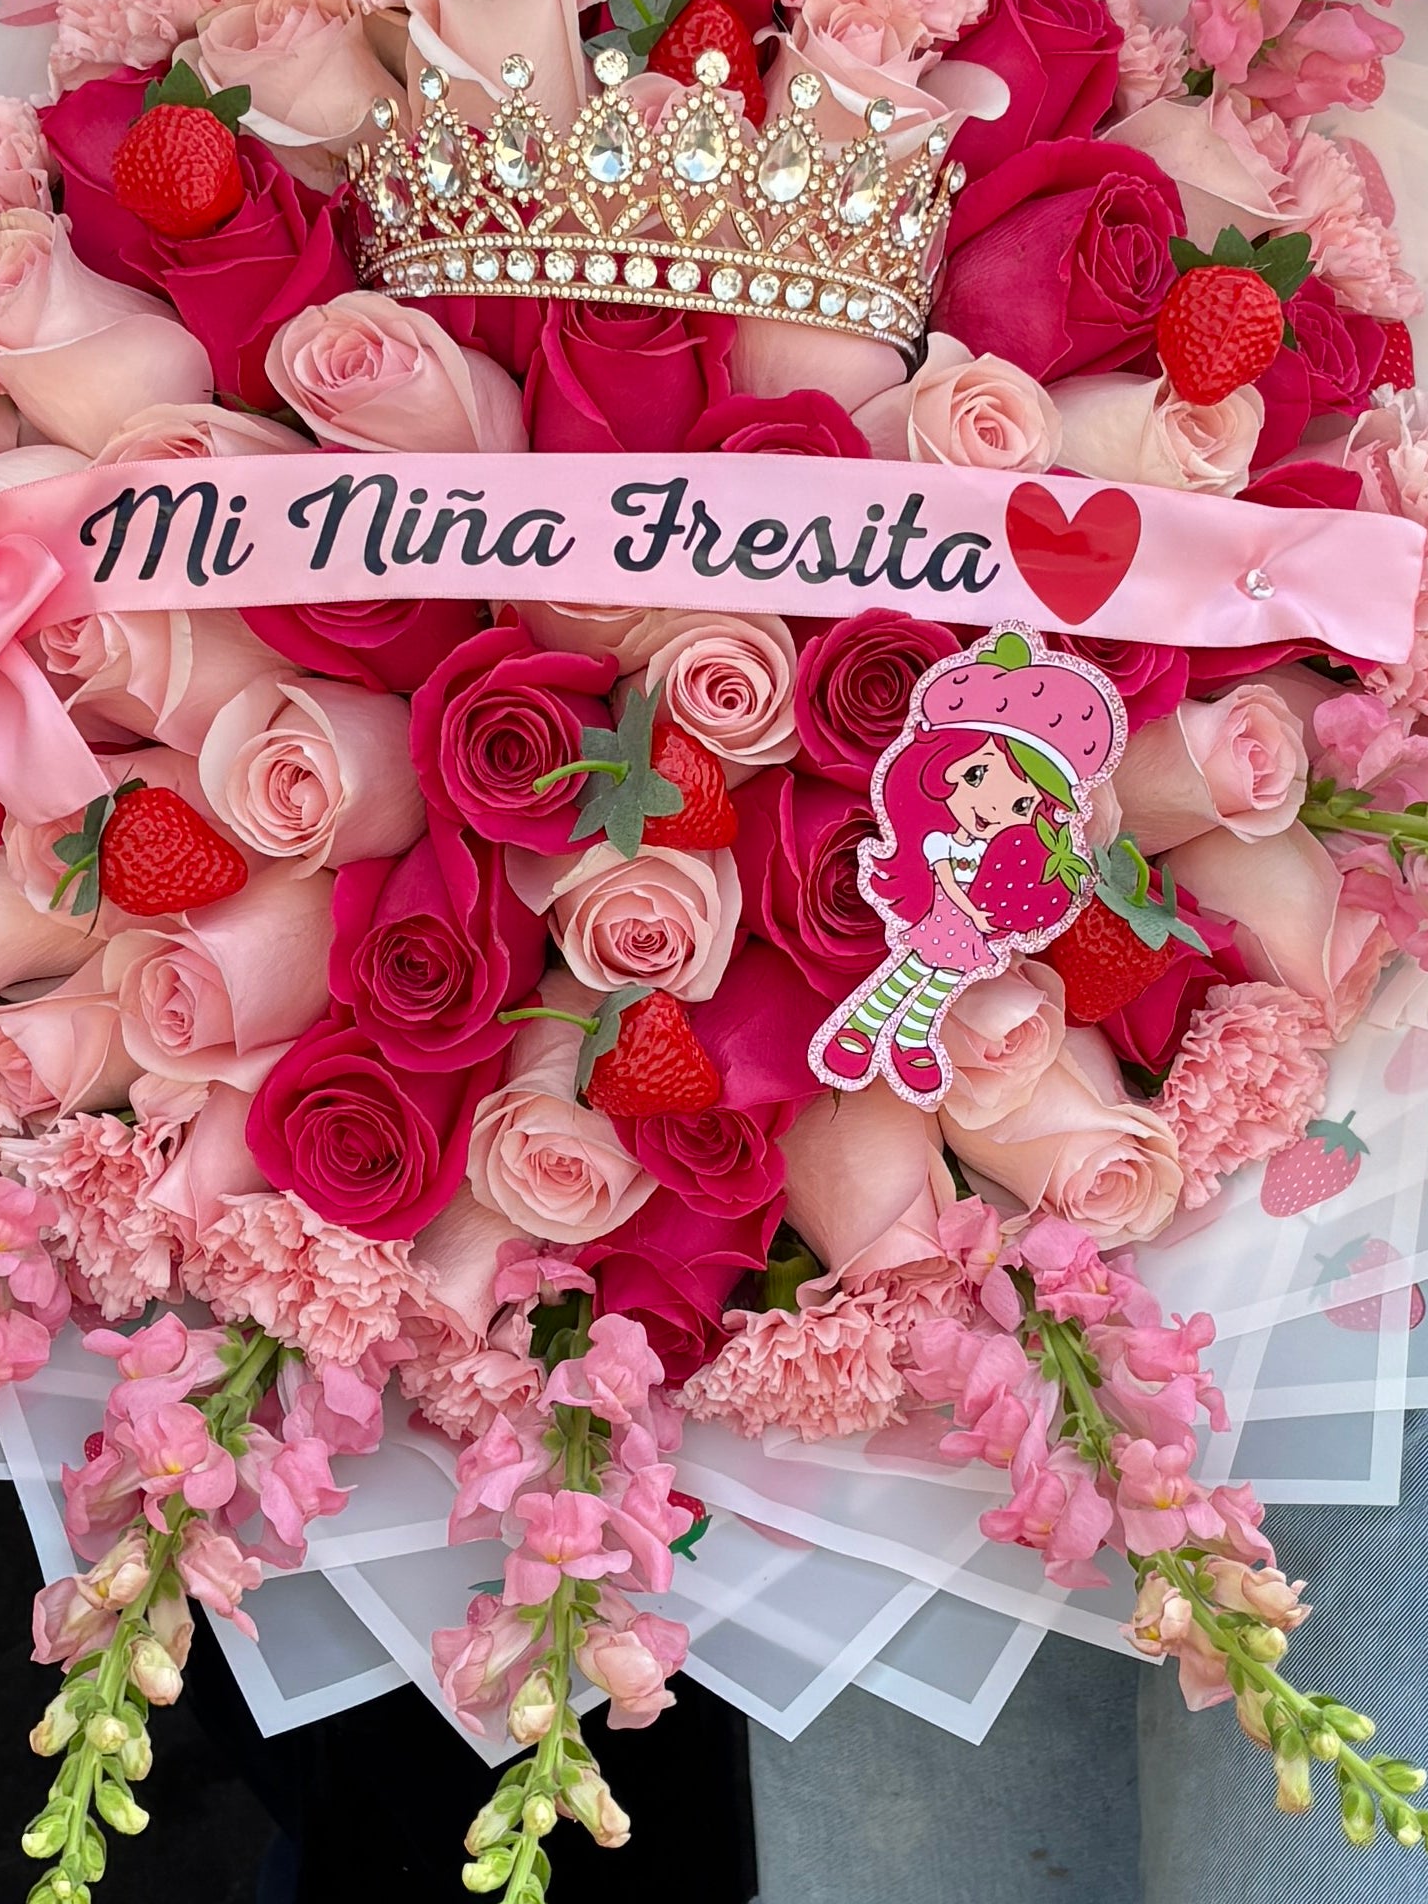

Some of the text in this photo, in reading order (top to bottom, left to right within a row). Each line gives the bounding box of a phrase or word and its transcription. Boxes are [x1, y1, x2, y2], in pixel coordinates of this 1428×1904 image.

[79, 472, 1000, 594] Mi Niña Fresita
